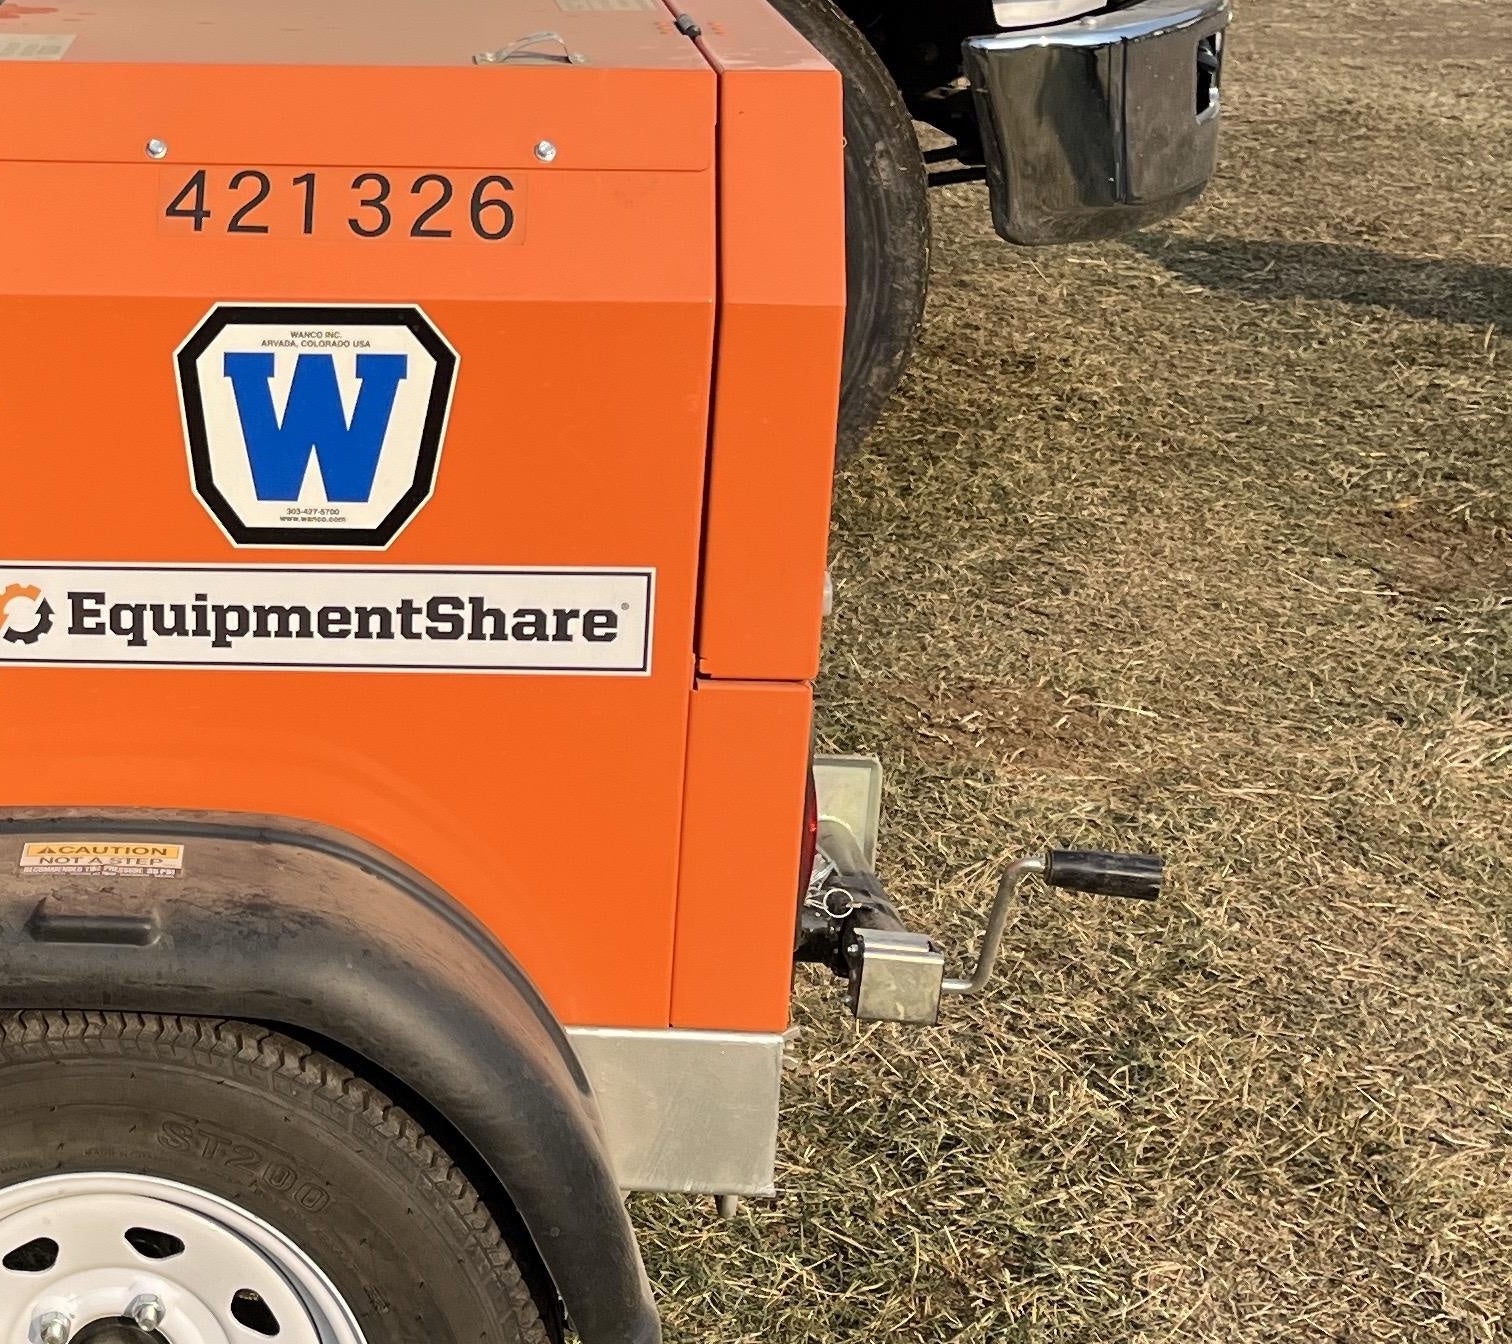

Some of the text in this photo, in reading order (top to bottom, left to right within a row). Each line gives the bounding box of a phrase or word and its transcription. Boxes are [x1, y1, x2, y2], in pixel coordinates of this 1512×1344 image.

[165, 169, 515, 241] 421326
[290, 331, 342, 339] WANCO INC.
[261, 339, 371, 348] ARVADA, COLORADO USA
[224, 352, 408, 503] W
[286, 508, 340, 516] 303-427-5700
[67, 591, 619, 648] EquipmentShare
[58, 845, 168, 856] CAUTION
[39, 856, 164, 866] NOT A STEP
[156, 1120, 331, 1214] ST200
